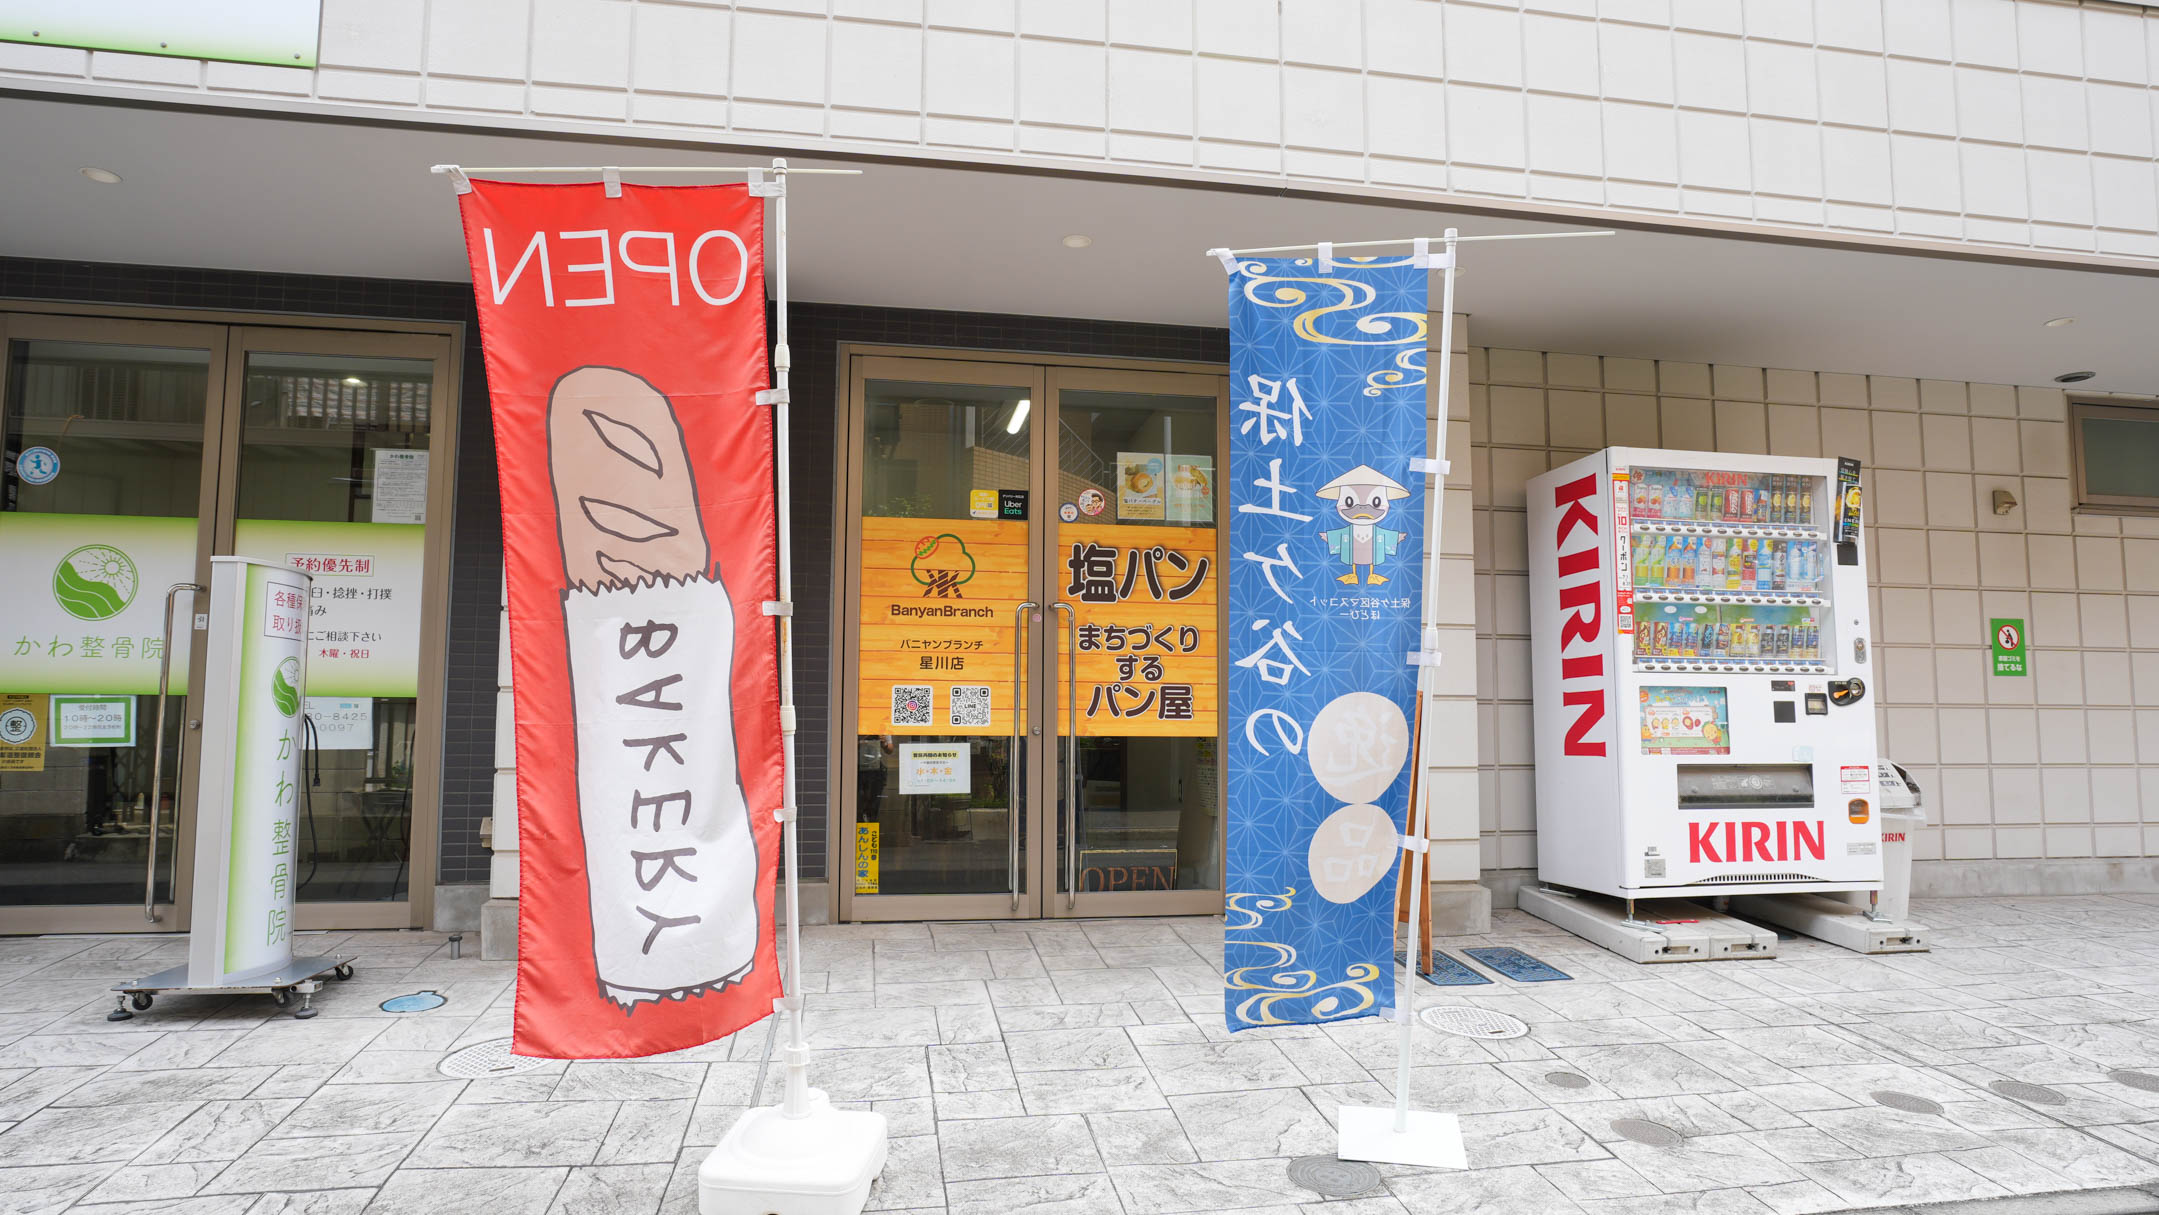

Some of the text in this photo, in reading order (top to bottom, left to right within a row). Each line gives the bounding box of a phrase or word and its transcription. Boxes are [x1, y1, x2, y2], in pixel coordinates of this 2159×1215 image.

[1705, 471, 1748, 487] KIRIN
[291, 557, 371, 573] 予約優先制
[1620, 535, 1628, 572] クーポン
[1067, 543, 1209, 603] 塩パン
[891, 604, 994, 618] BanyanBranch
[1555, 473, 1607, 758] KIRIN
[14, 635, 164, 659] かわ整骨院
[900, 639, 983, 650] バニヤンブランチ
[1078, 624, 1199, 652] まちづくり
[919, 656, 965, 670] 星川店
[1115, 655, 1164, 681] する
[1086, 683, 1194, 720] パン屋
[266, 728, 296, 947] かわ整骨院
[1688, 820, 1825, 863] KIRIN
[1080, 866, 1176, 891] OPEN
